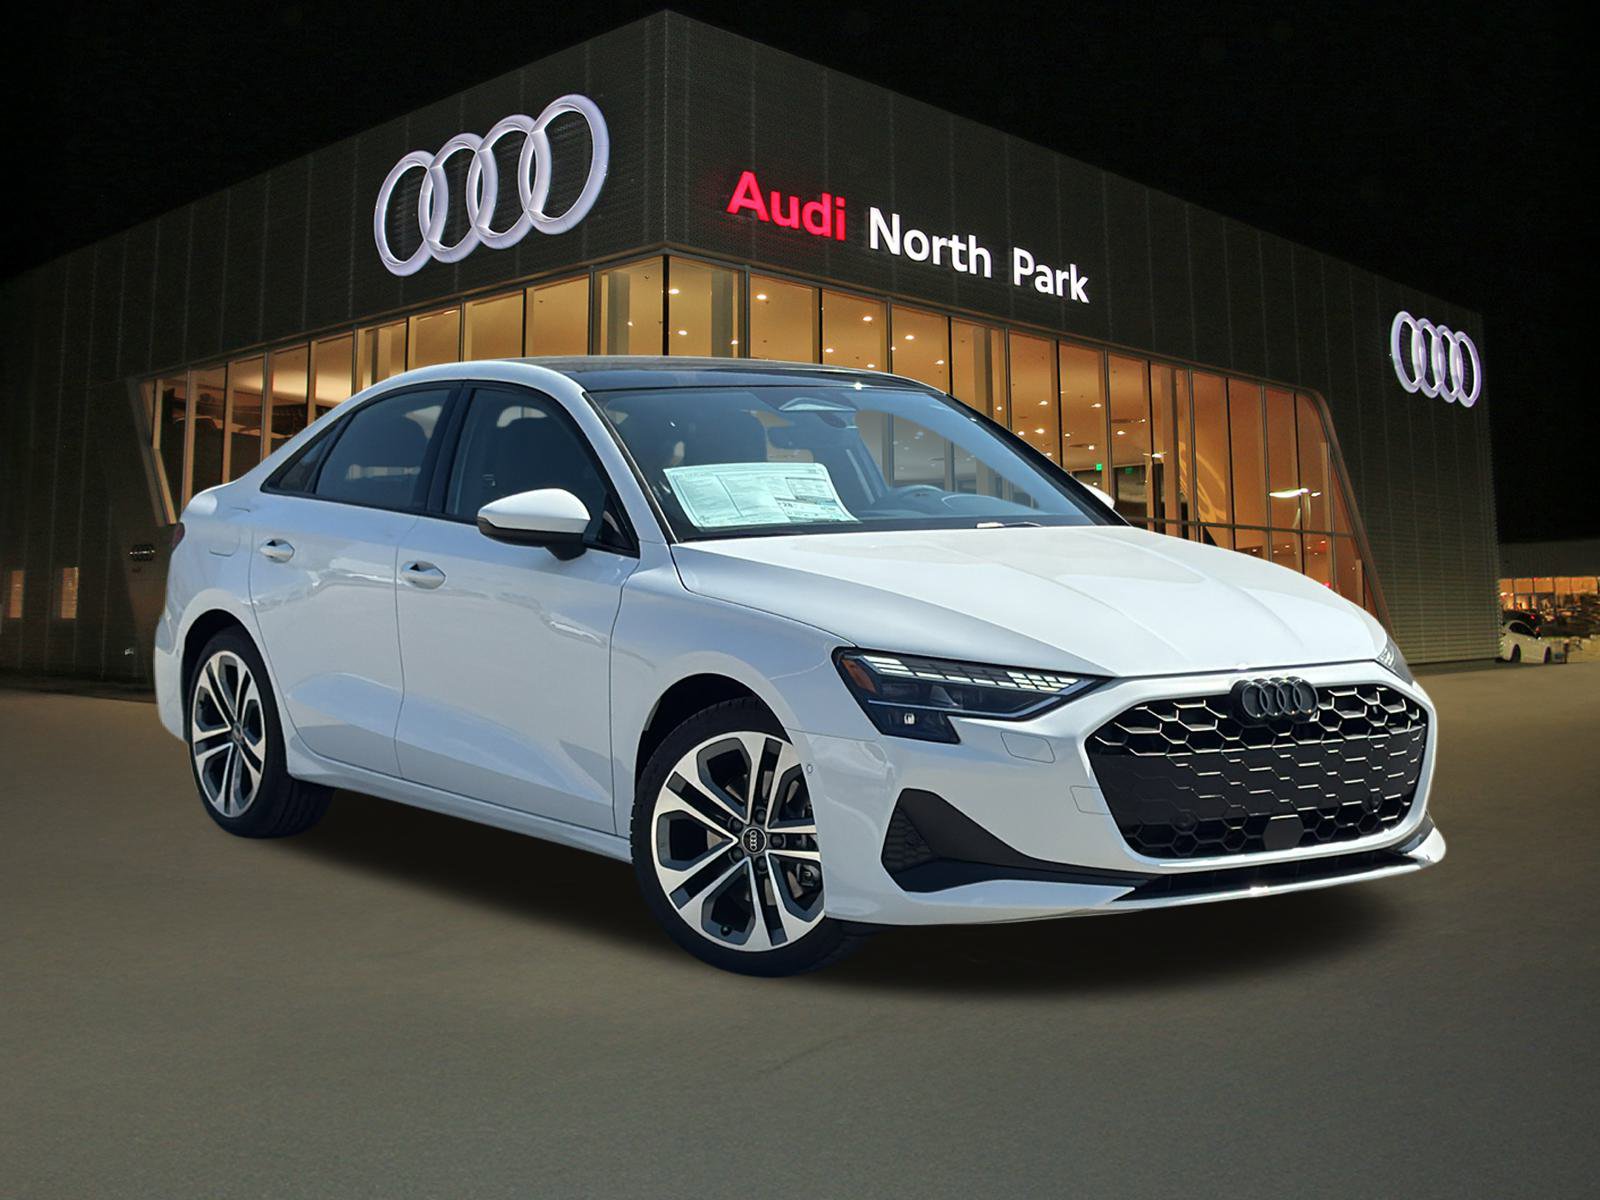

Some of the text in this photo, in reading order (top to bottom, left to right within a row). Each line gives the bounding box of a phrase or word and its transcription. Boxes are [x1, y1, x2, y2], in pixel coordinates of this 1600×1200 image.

[726, 170, 1091, 304] Audi North Park
